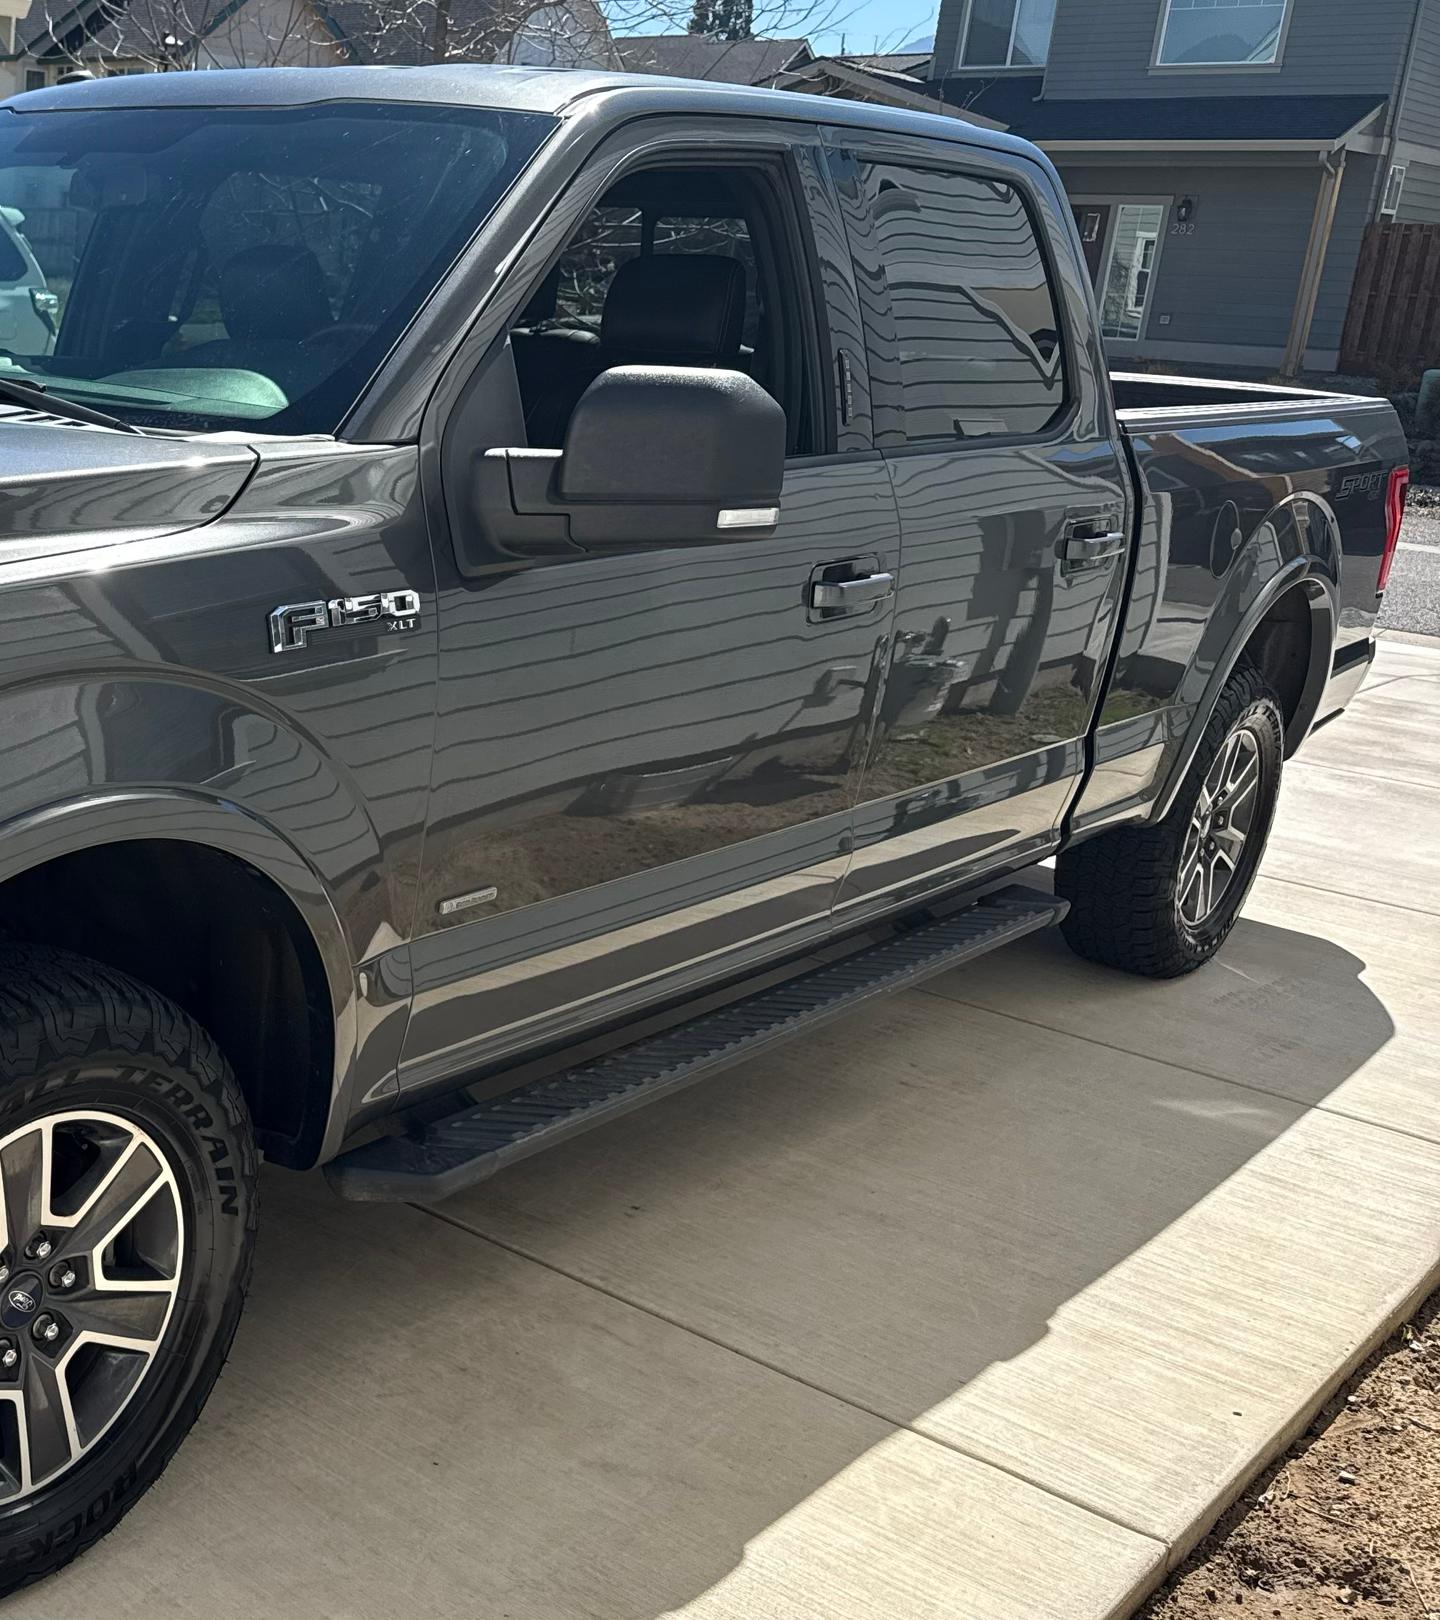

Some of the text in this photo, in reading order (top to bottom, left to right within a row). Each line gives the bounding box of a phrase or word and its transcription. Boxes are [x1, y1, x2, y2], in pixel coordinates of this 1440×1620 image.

[1170, 223, 1195, 235] 282
[1335, 470, 1389, 501] SPORT
[387, 618, 416, 632] XLT
[115, 1063, 240, 1217] TERRAIN
